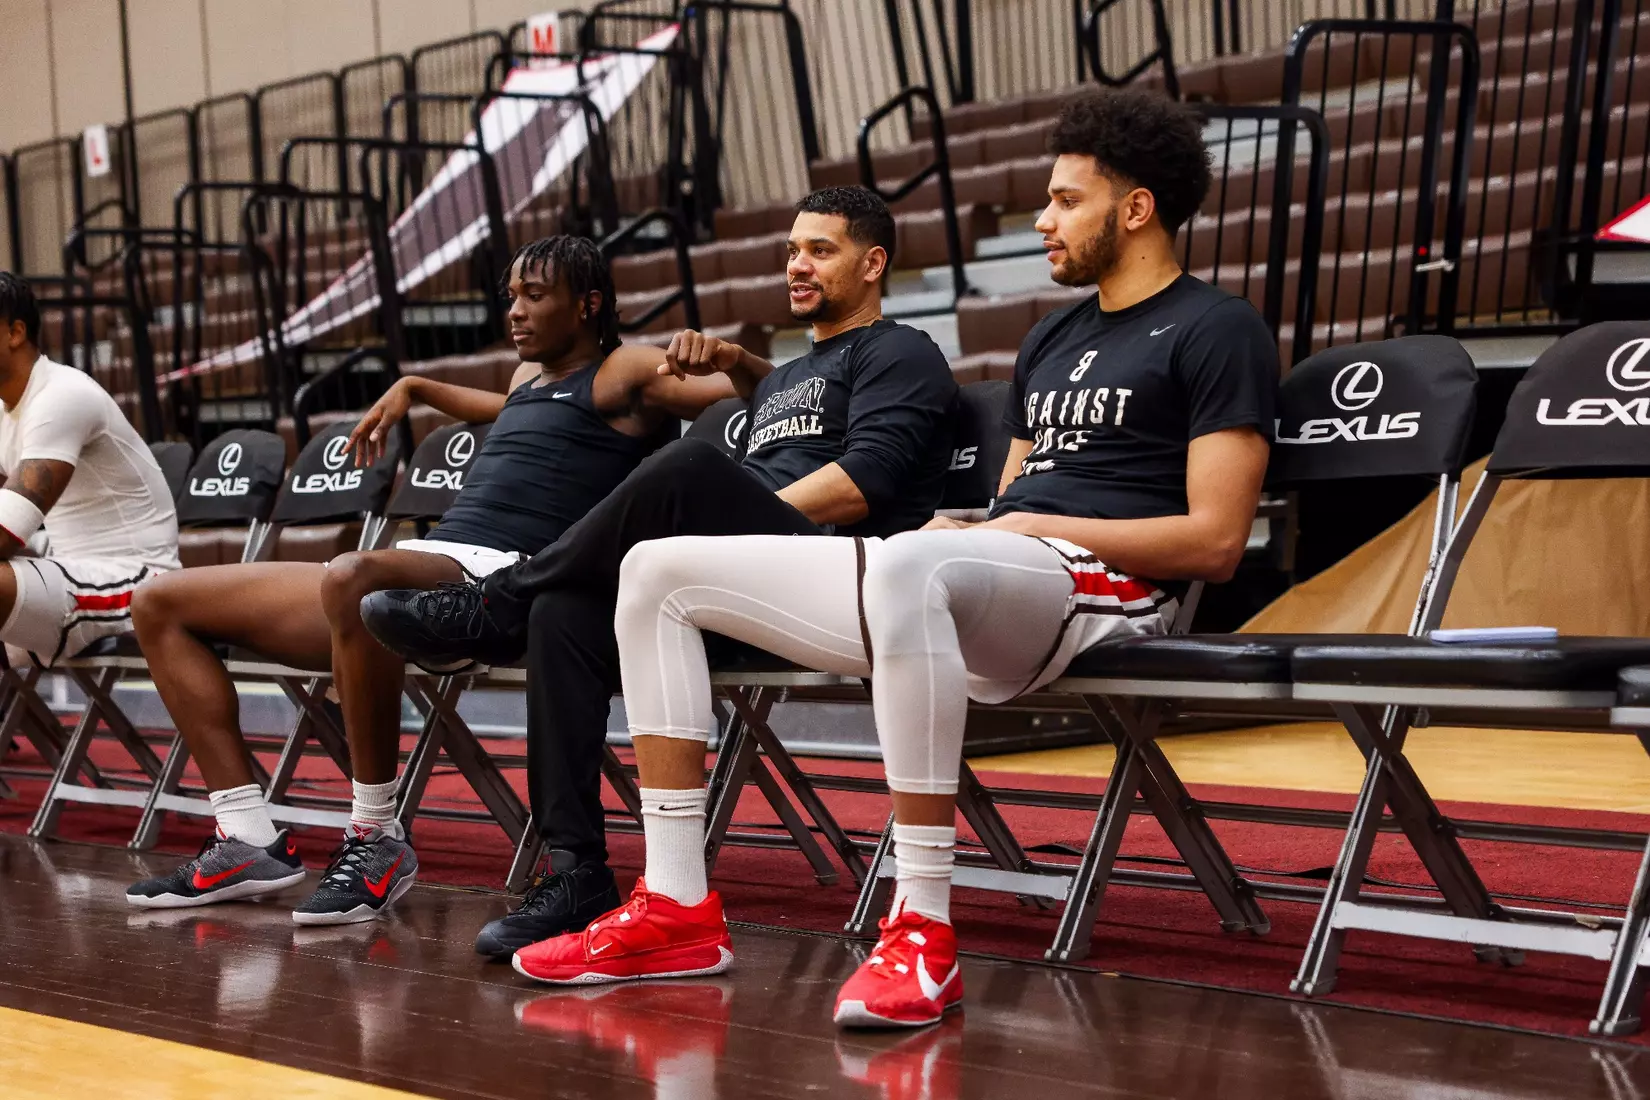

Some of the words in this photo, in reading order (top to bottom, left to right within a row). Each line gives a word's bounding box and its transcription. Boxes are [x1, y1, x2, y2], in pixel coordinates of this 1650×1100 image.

[1069, 350, 1099, 382] 8
[1024, 387, 1133, 428] GAINST
[1274, 411, 1422, 444] LEXUS
[190, 477, 250, 497] LEXUS
[292, 469, 364, 494] LEXUS
